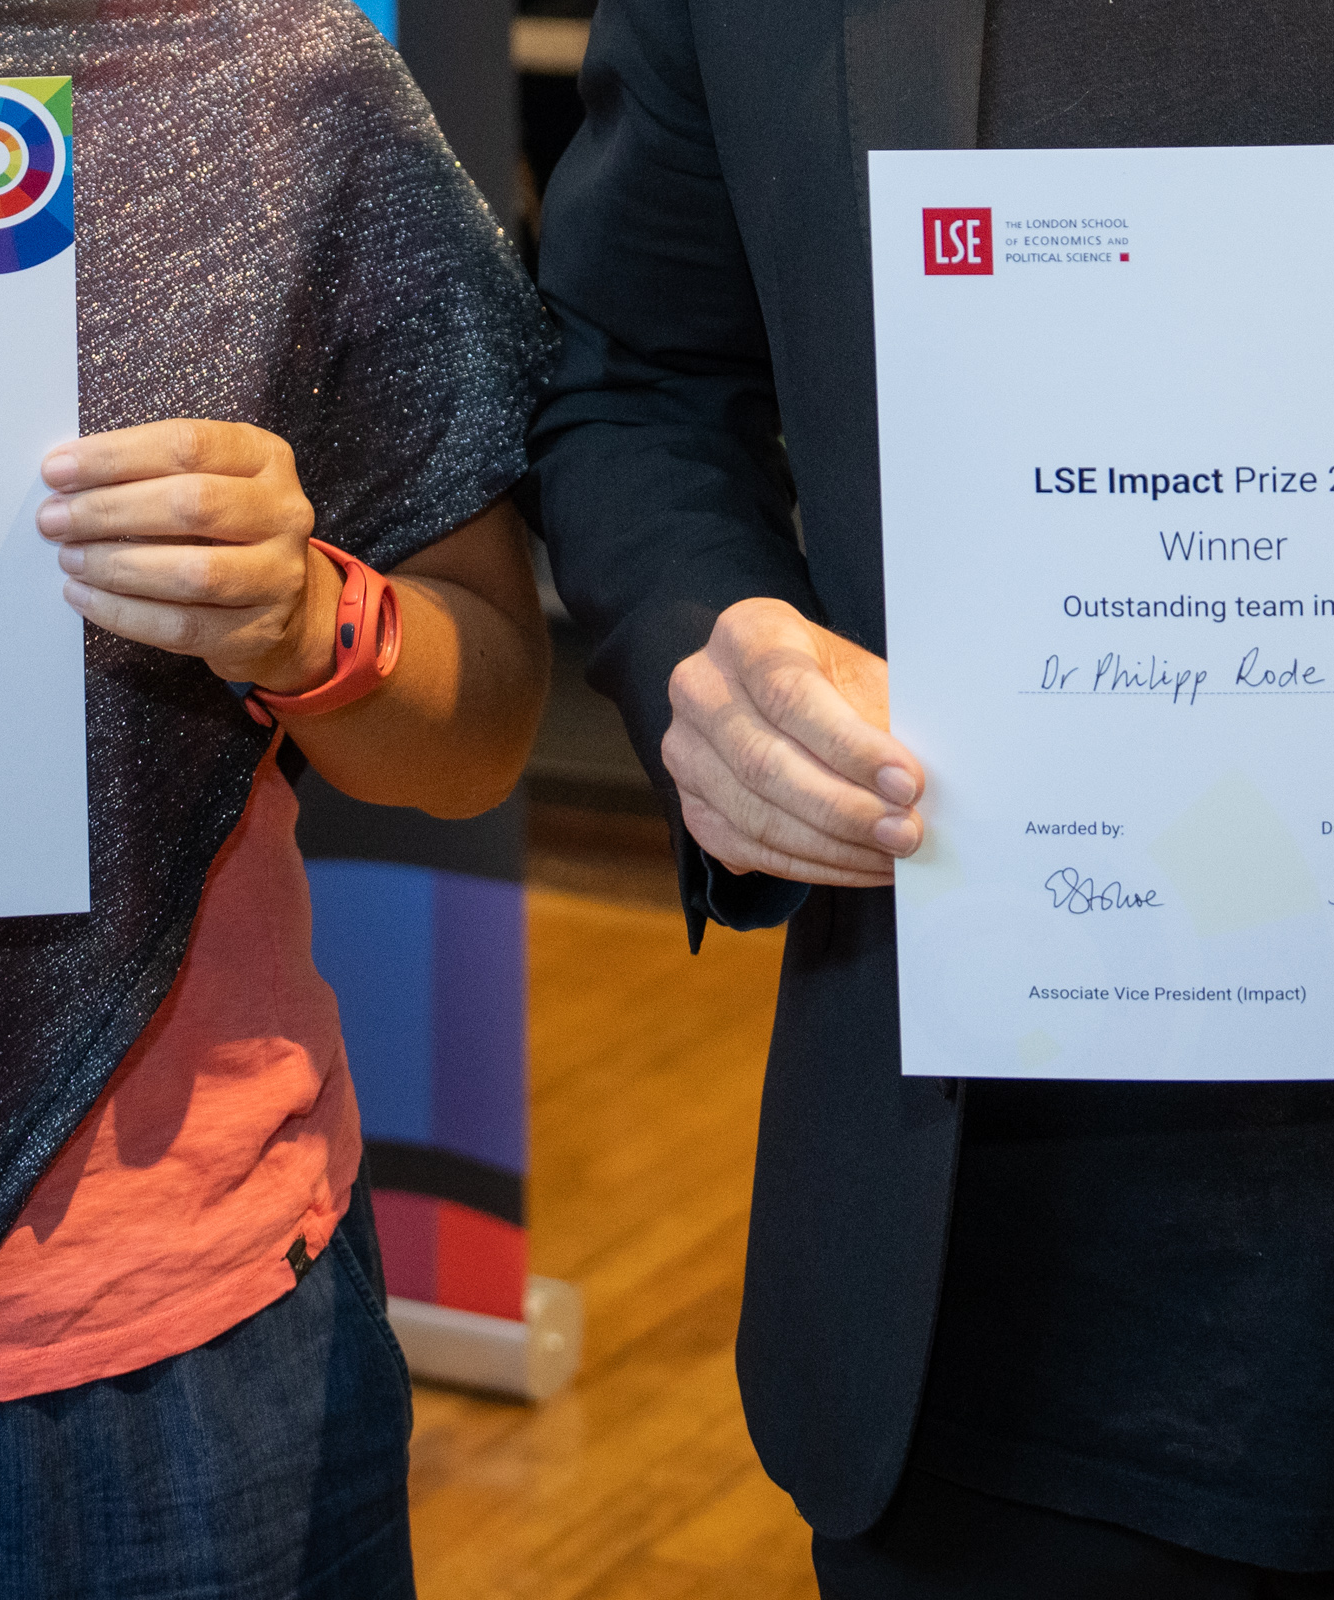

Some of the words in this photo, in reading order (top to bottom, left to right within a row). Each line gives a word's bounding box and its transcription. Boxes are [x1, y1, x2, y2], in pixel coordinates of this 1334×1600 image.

[1005, 220, 1022, 230] THE
[1025, 218, 1078, 230] LONDON
[1080, 218, 1130, 229] SCHOOL
[934, 219, 982, 264] LSE
[1005, 238, 1018, 247] OF
[1023, 235, 1102, 247] ECONOMICS
[1107, 237, 1130, 246] AND
[1005, 252, 1063, 264] POLITICAL
[1065, 252, 1113, 263] SCIENCE
[1034, 466, 1098, 495] LSE
[1107, 466, 1225, 502] Impact
[1235, 464, 1318, 494] Prize
[1159, 530, 1289, 562] Winner
[1062, 594, 1227, 624] Outstanding
[1234, 596, 1305, 618] team
[1040, 654, 1079, 691] Dr
[1092, 651, 1208, 705] Philipp
[1235, 646, 1325, 688] Rode
[1024, 820, 1098, 836] Awarded
[1101, 820, 1125, 840] by:
[1028, 985, 1110, 1001] Associate
[1113, 986, 1150, 1002] Vice
[1154, 985, 1233, 1002] President
[1236, 985, 1307, 1005] (Impact)
